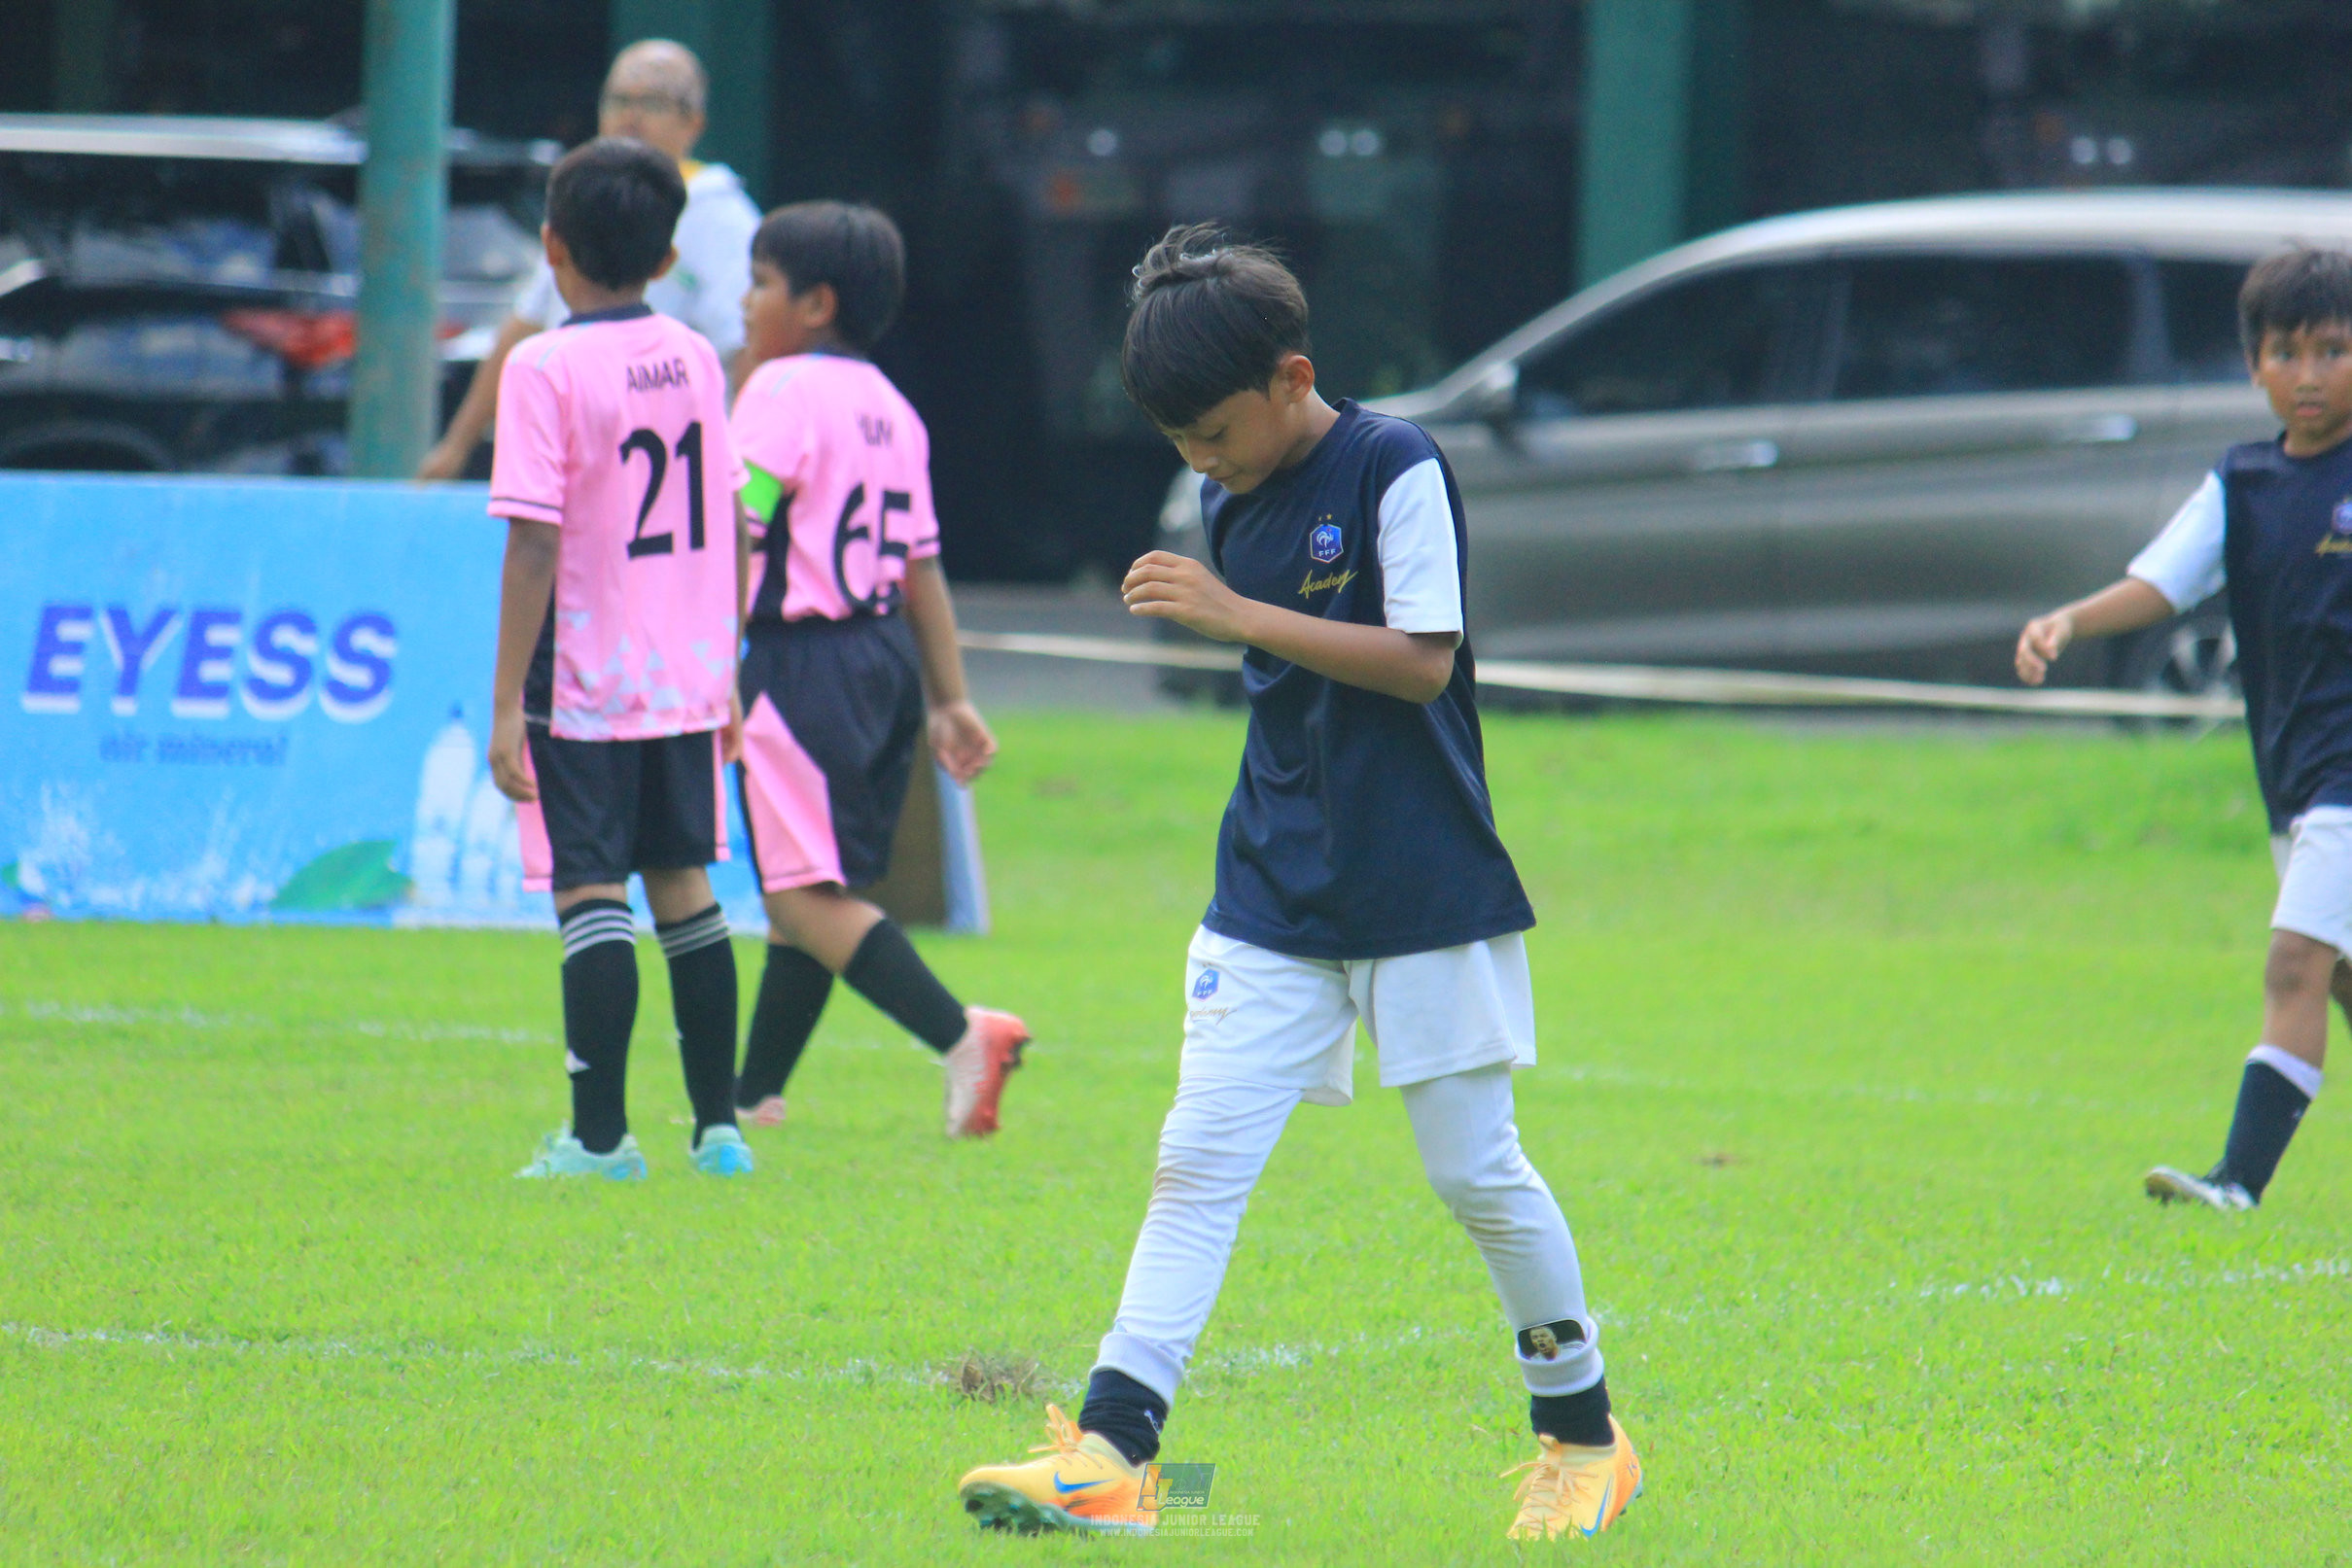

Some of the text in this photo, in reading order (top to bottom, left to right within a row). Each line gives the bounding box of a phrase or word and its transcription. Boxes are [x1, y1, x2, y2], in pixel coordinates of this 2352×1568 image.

[627, 358, 689, 393] AIMAR
[618, 420, 706, 560] 21
[833, 482, 912, 615] 65
[1318, 548, 1336, 557] FFF
[21, 603, 398, 721] EYESS
